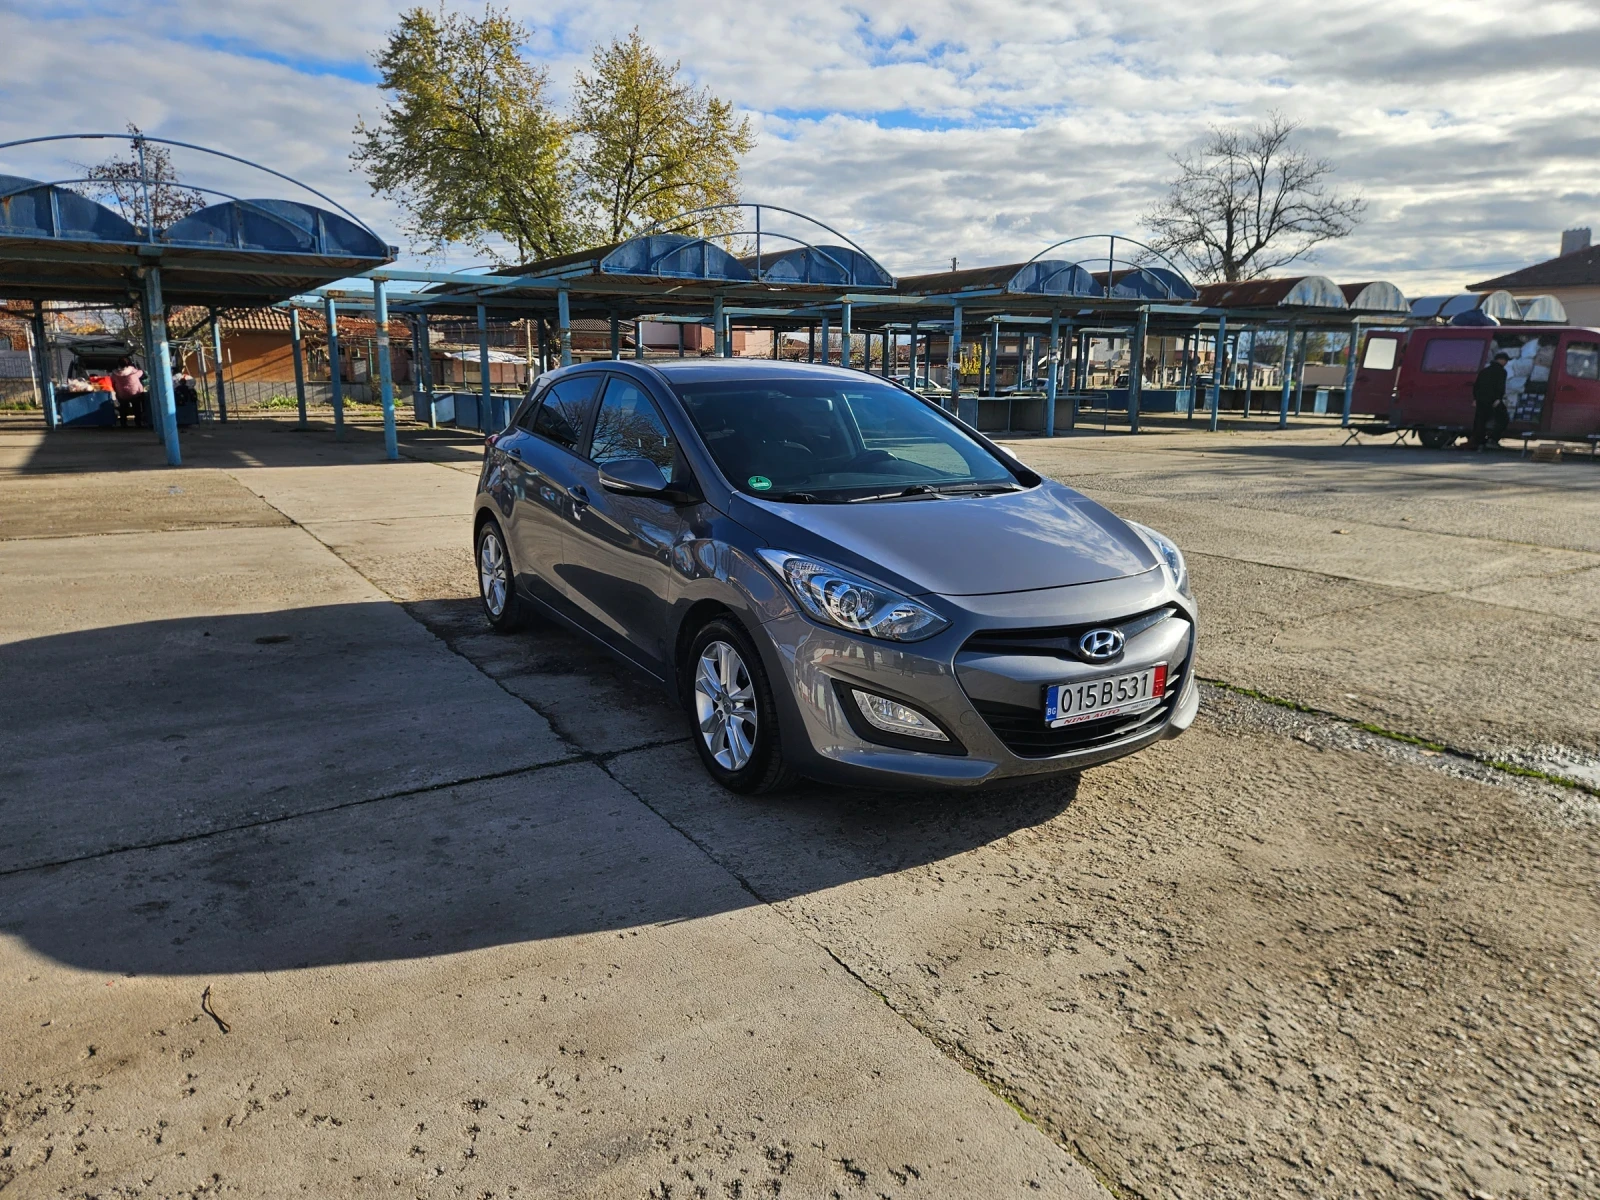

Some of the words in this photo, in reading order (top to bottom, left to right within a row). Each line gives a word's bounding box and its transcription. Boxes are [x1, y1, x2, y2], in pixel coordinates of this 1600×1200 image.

[1061, 673, 1148, 713] 015B531
[1047, 707, 1057, 715] BG
[1063, 715, 1091, 724] NINA
[1092, 708, 1121, 718] AUTO
